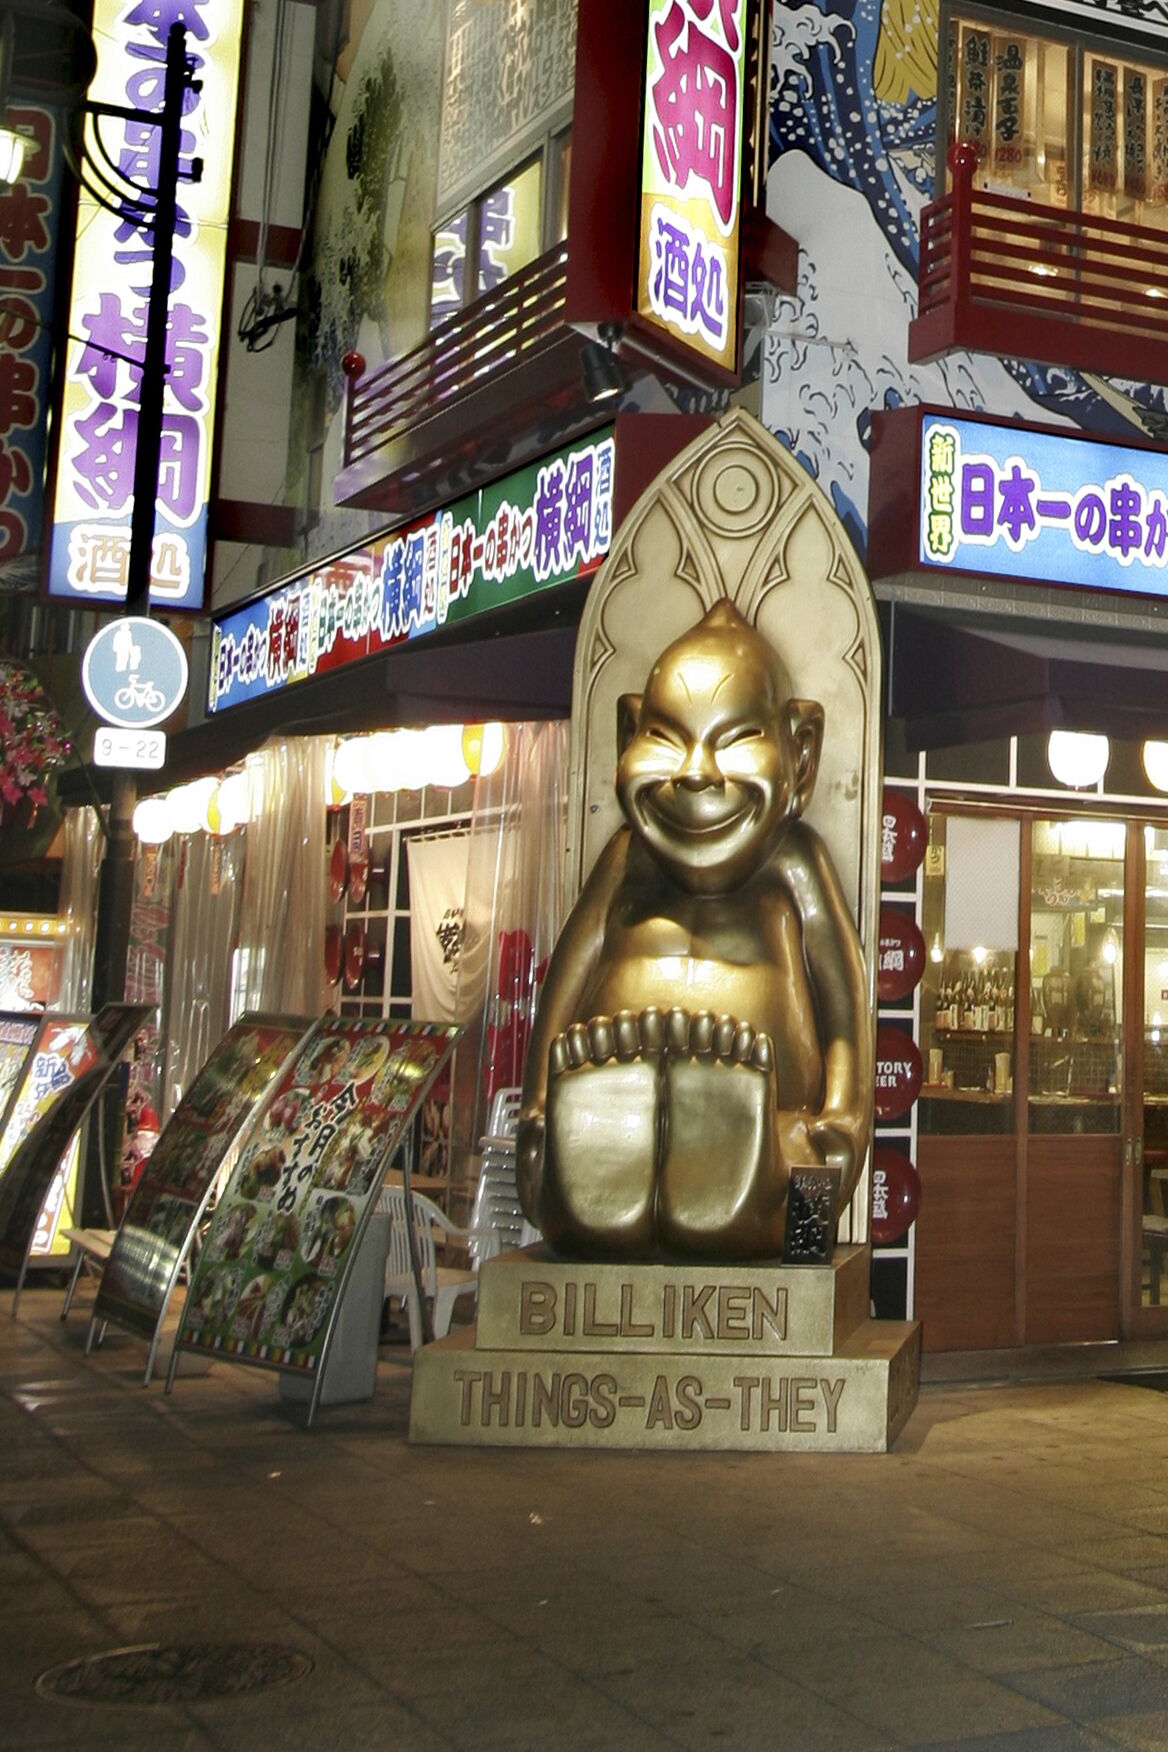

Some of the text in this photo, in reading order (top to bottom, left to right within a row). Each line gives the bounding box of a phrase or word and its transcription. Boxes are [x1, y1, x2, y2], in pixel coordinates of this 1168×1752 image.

[654, 216, 725, 336] 酒処
[75, 292, 209, 519] 横綱
[536, 461, 593, 578] 横綱
[928, 431, 955, 554] 新世界
[876, 1060, 912, 1075] TORY
[520, 1281, 787, 1341] BILLIKEN
[454, 1370, 846, 1432] THINGS-AS-THEY
